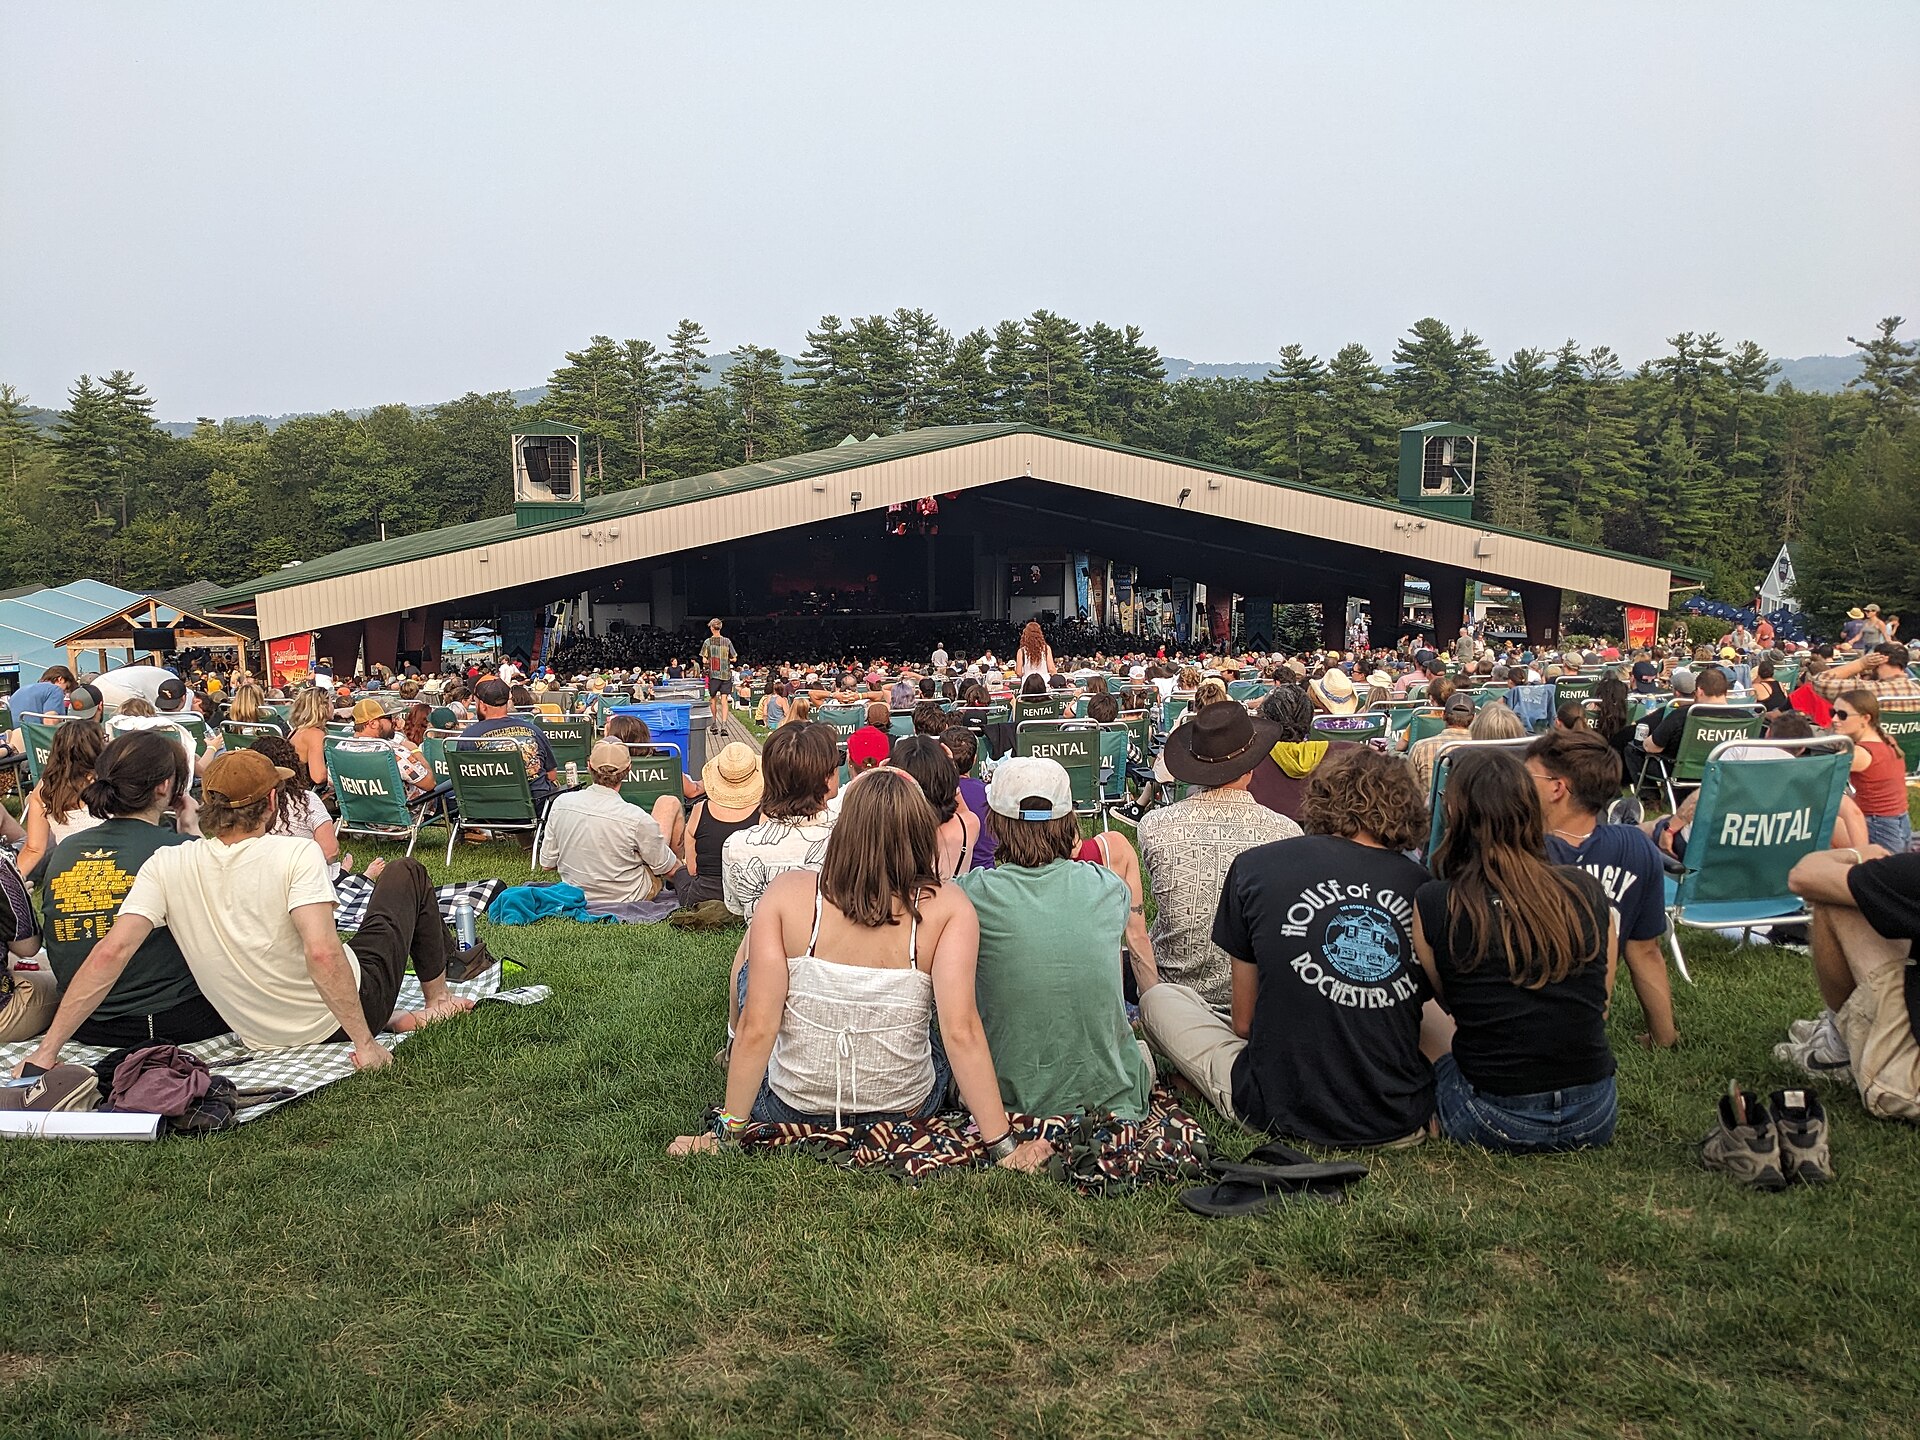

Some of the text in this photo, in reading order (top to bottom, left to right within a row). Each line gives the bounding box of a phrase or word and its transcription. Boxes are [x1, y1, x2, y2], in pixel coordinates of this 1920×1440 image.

[1560, 690, 1590, 699] RENTAL
[1023, 706, 1054, 717] RENTAL
[1696, 728, 1749, 742] RENTAL
[1031, 741, 1088, 757] RENTAL
[460, 763, 514, 778] RENTAL
[339, 775, 389, 796] RENTAL
[1719, 807, 1813, 846] RENTAL
[1280, 879, 1347, 938] HOUSE
